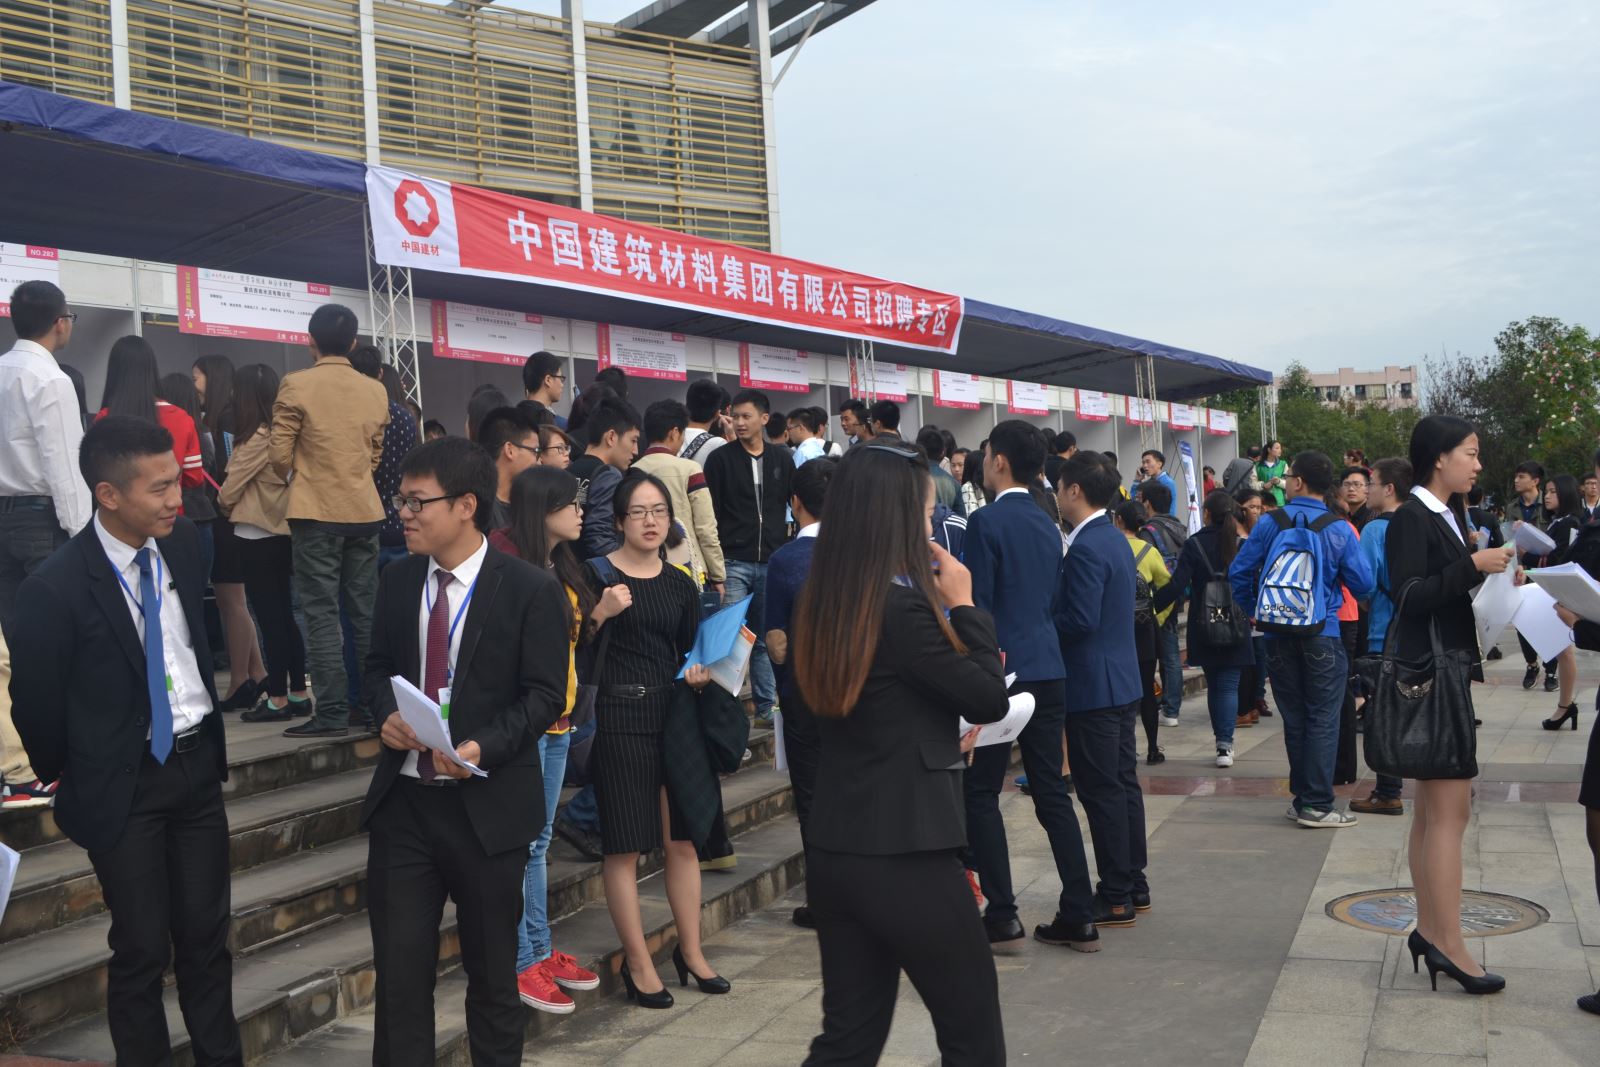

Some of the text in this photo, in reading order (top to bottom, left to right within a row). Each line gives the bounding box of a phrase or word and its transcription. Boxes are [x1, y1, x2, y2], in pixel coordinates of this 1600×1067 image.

[402, 240, 440, 256] 中国建材
[507, 209, 951, 337] 中国建筑材料集团有限公司招聘专区
